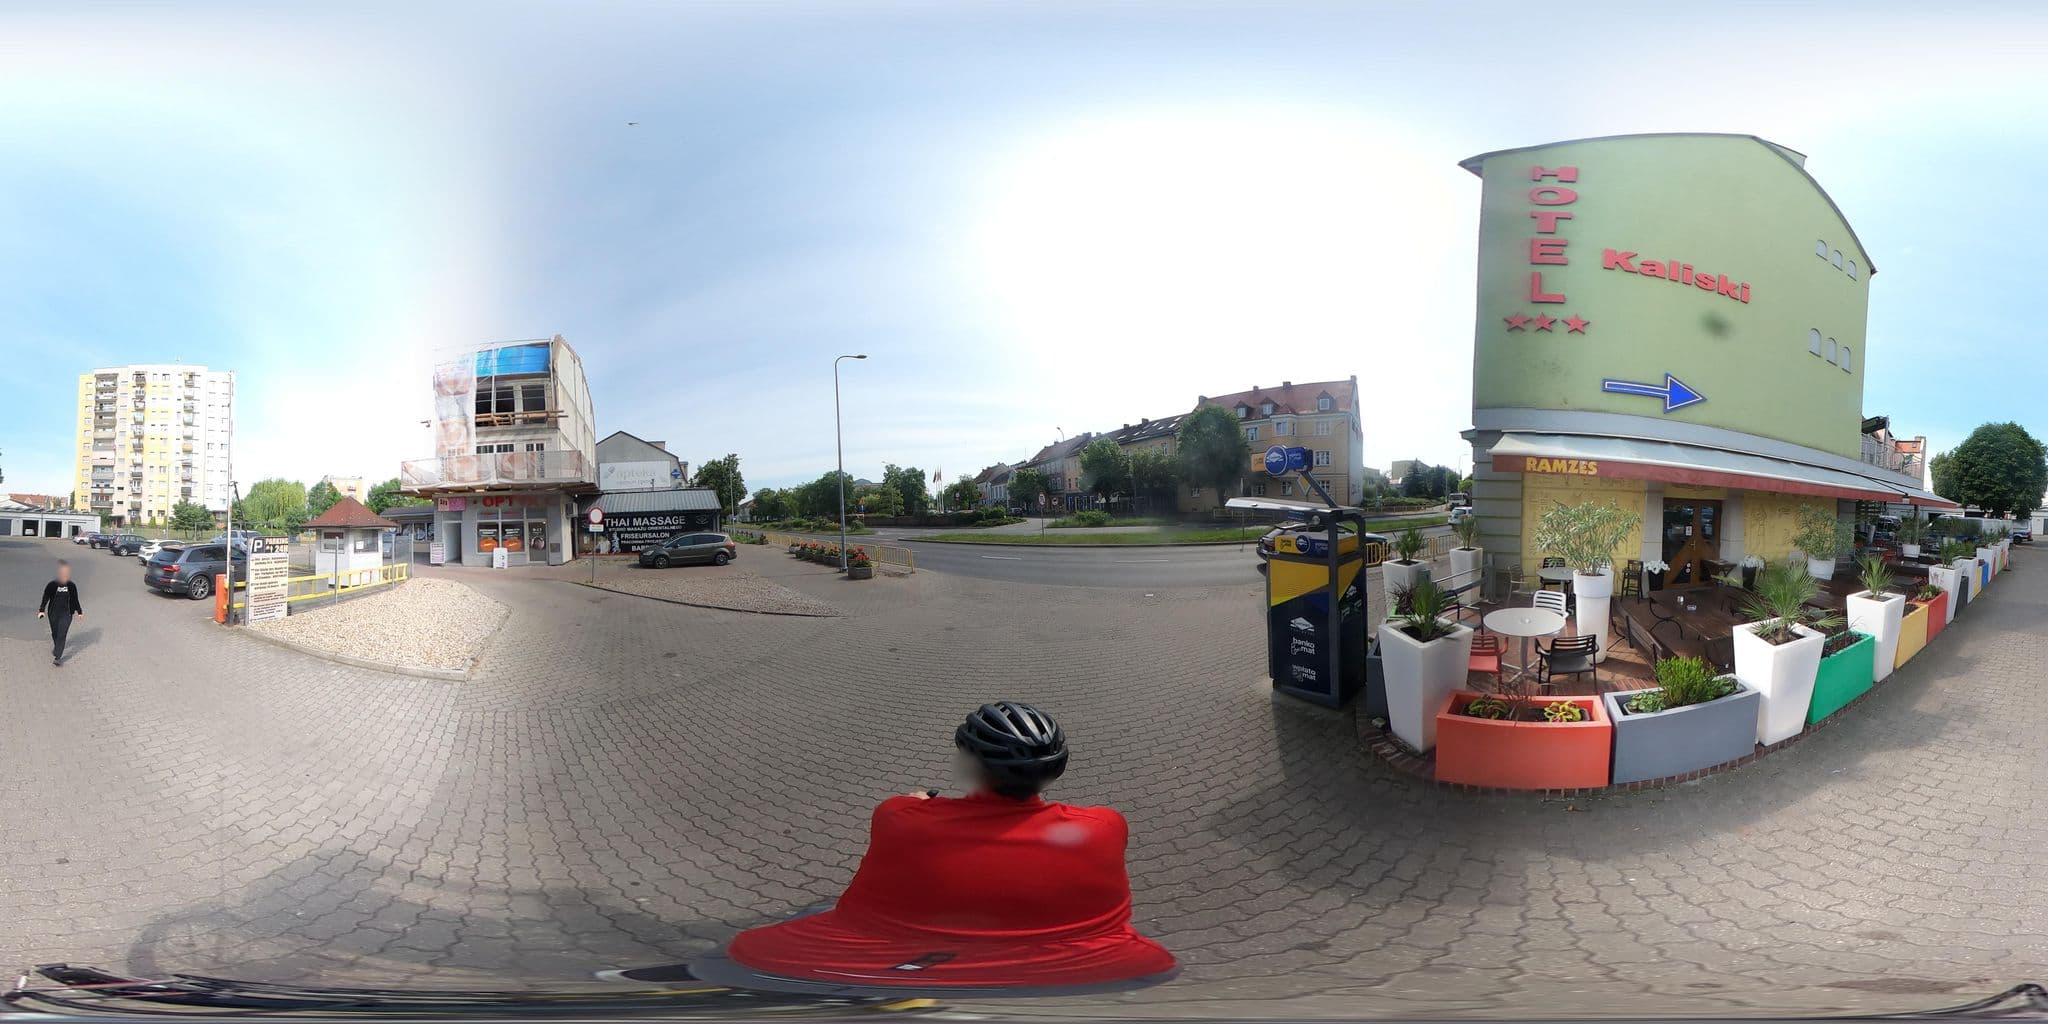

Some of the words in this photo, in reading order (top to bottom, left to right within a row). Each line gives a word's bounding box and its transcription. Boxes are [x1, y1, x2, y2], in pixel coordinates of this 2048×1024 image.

[1530, 166, 1578, 304] HOTEL
[1602, 248, 1751, 304] Kaliski
[1526, 457, 1598, 475] RAMZES
[604, 518, 630, 527] THAI
[633, 516, 686, 527] MASSAGE
